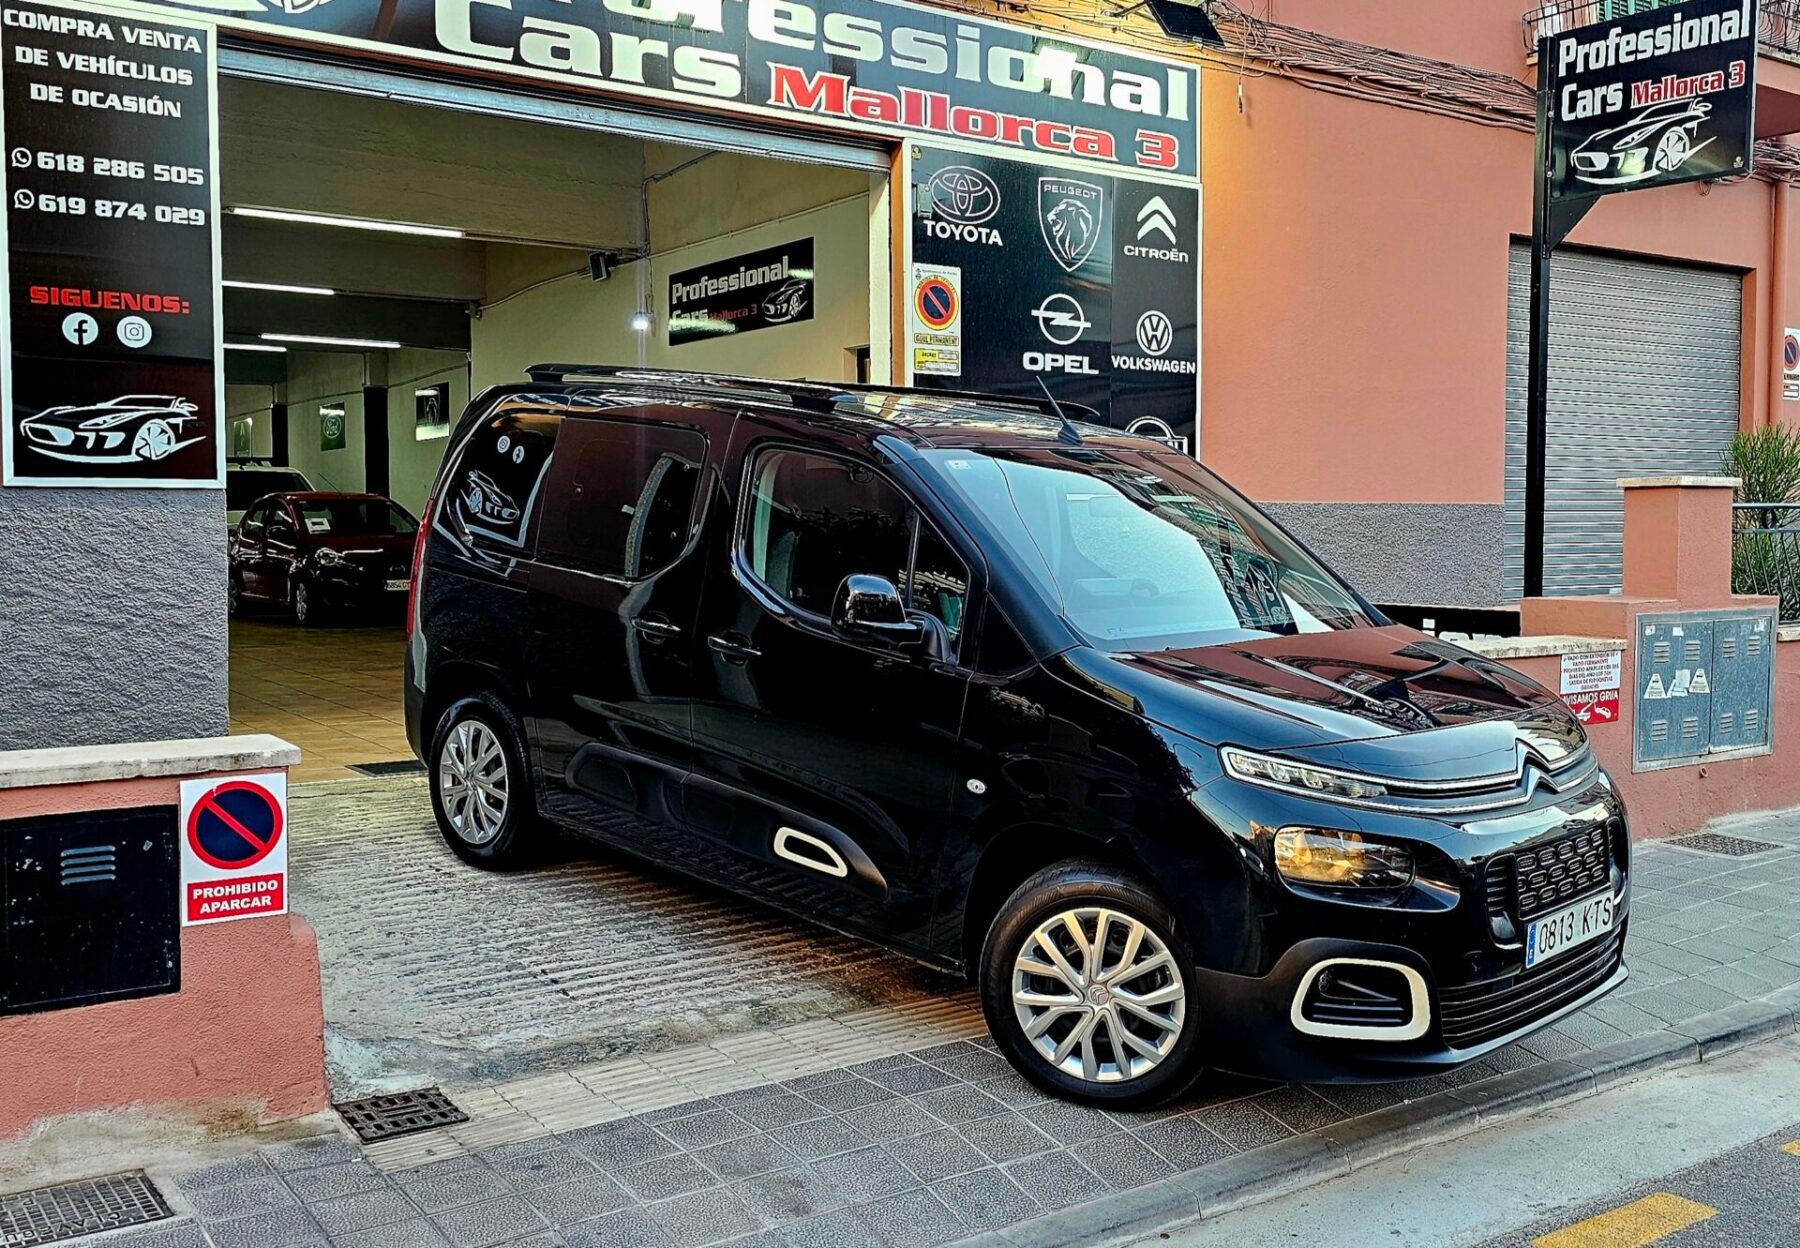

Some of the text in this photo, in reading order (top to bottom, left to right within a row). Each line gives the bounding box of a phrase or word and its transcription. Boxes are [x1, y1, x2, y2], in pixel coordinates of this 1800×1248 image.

[4, 9, 202, 53] COMPRA VENTA
[1558, 0, 1750, 77] Professional
[15, 46, 193, 85] DE VEHÍCULOS
[435, 0, 741, 98] Cars
[556, 0, 1189, 121] essional
[30, 83, 181, 118] DE OCASIÓN
[1561, 60, 1746, 122] Cars Mallorca 3
[766, 61, 1178, 170] Mallorca 3
[37, 152, 204, 185] 618 286 505
[1044, 184, 1097, 199] PEUGEOT
[39, 194, 205, 226] 619 874 029
[923, 220, 1003, 246] TOYOTA
[672, 255, 789, 305] Professional
[30, 286, 190, 315] SIGUENOS:
[751, 303, 759, 315] 3
[1022, 352, 1099, 374] OPEL
[1111, 355, 1196, 374] VOLKSWAGEN
[1600, 690, 1618, 701] GRUA
[193, 880, 278, 900] PROHIBIDO
[200, 895, 272, 914] APARCAR
[1539, 897, 1611, 954] 0813 KTS
